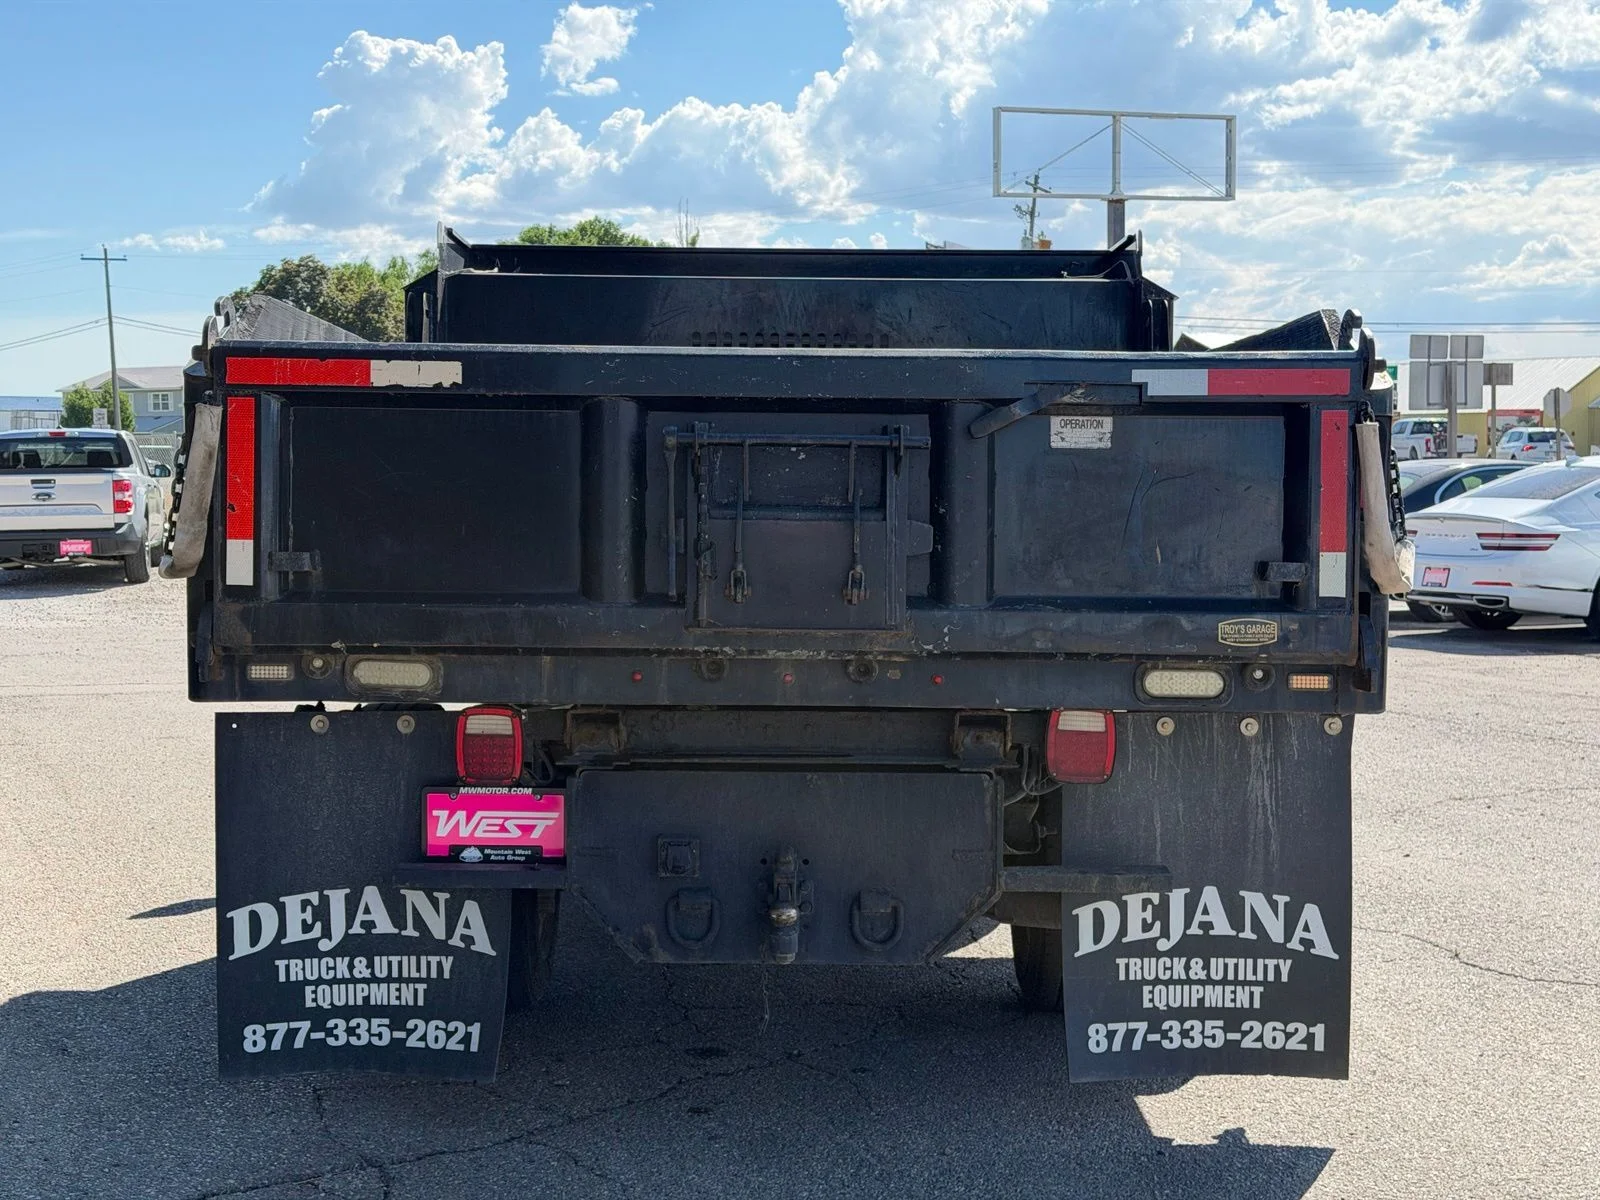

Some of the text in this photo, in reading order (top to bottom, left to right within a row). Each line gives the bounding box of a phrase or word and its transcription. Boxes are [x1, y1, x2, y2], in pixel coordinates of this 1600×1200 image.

[1059, 419, 1104, 429] OPERATION
[1221, 624, 1275, 634] TROY'S GARAGE
[459, 787, 533, 795] MWMOTOR.COM
[432, 810, 560, 838] WEST
[226, 885, 497, 960] DEJANA
[1071, 885, 1340, 960] DEJANA
[304, 982, 427, 1008] EQUIPMENT
[1142, 985, 1264, 1010] EQUIPMENT
[242, 1018, 481, 1053] 877-335-2621
[1087, 1020, 1325, 1054] 877-335-2621
